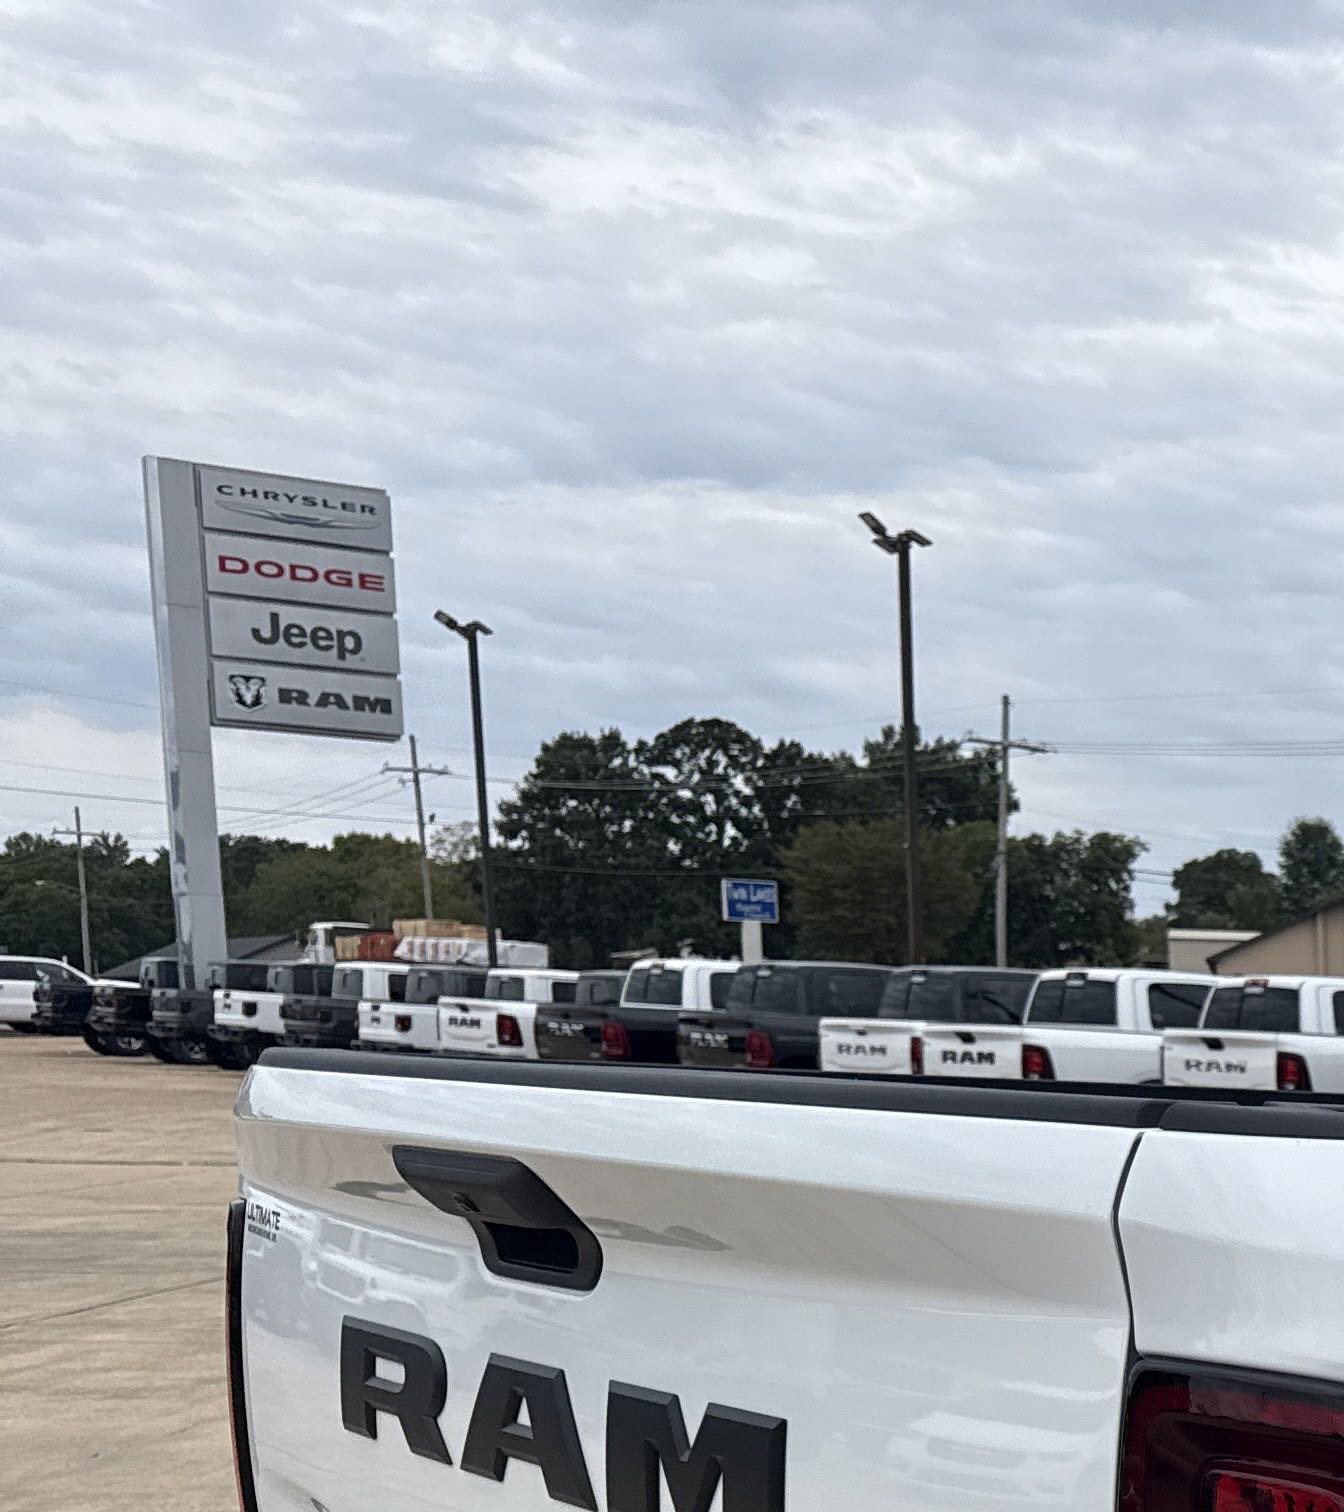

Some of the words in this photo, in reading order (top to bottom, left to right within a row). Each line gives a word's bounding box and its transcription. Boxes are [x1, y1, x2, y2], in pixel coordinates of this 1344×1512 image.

[216, 484, 376, 516] CHRYSLER
[218, 555, 385, 592] DODGE
[251, 612, 362, 661] Jeep
[277, 687, 393, 715] RAM
[448, 1017, 481, 1029] RAM
[837, 1043, 888, 1057] RAM
[941, 1050, 996, 1065] RAM
[1184, 1058, 1248, 1073] RAM
